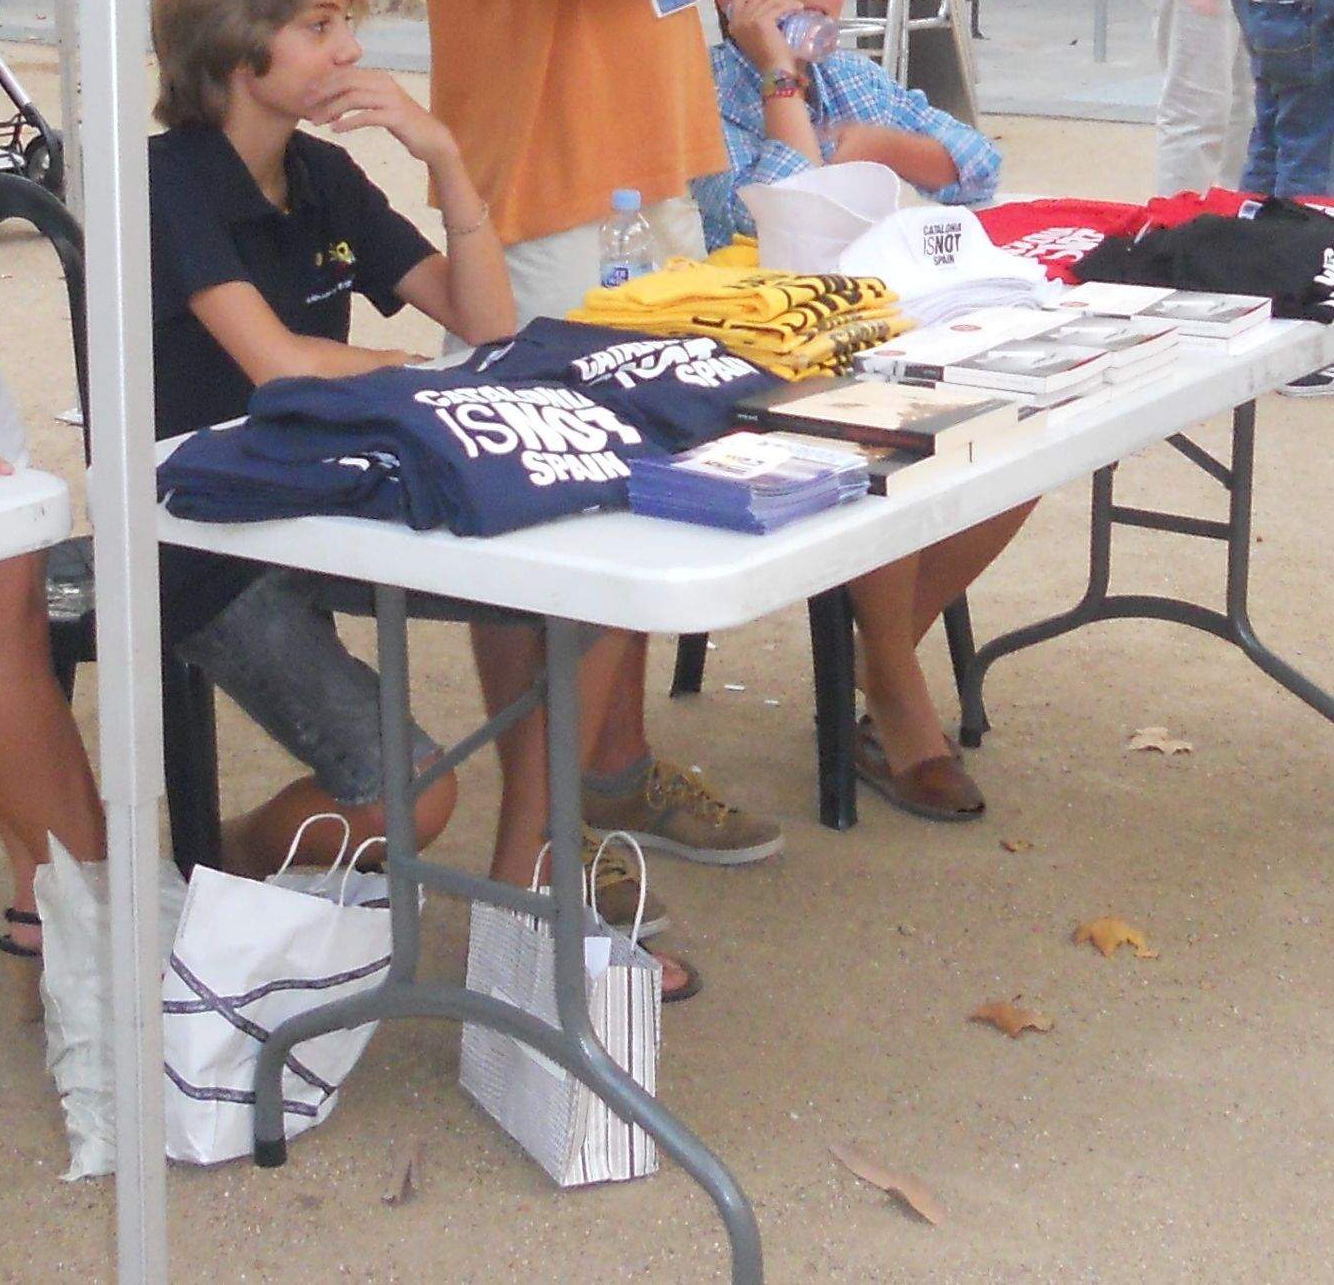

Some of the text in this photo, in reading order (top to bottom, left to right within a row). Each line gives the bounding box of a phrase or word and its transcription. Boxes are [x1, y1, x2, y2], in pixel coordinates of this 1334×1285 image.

[923, 222, 962, 236] CATALONIA
[933, 255, 955, 266] SPAIN
[520, 450, 632, 487] SPAIN
